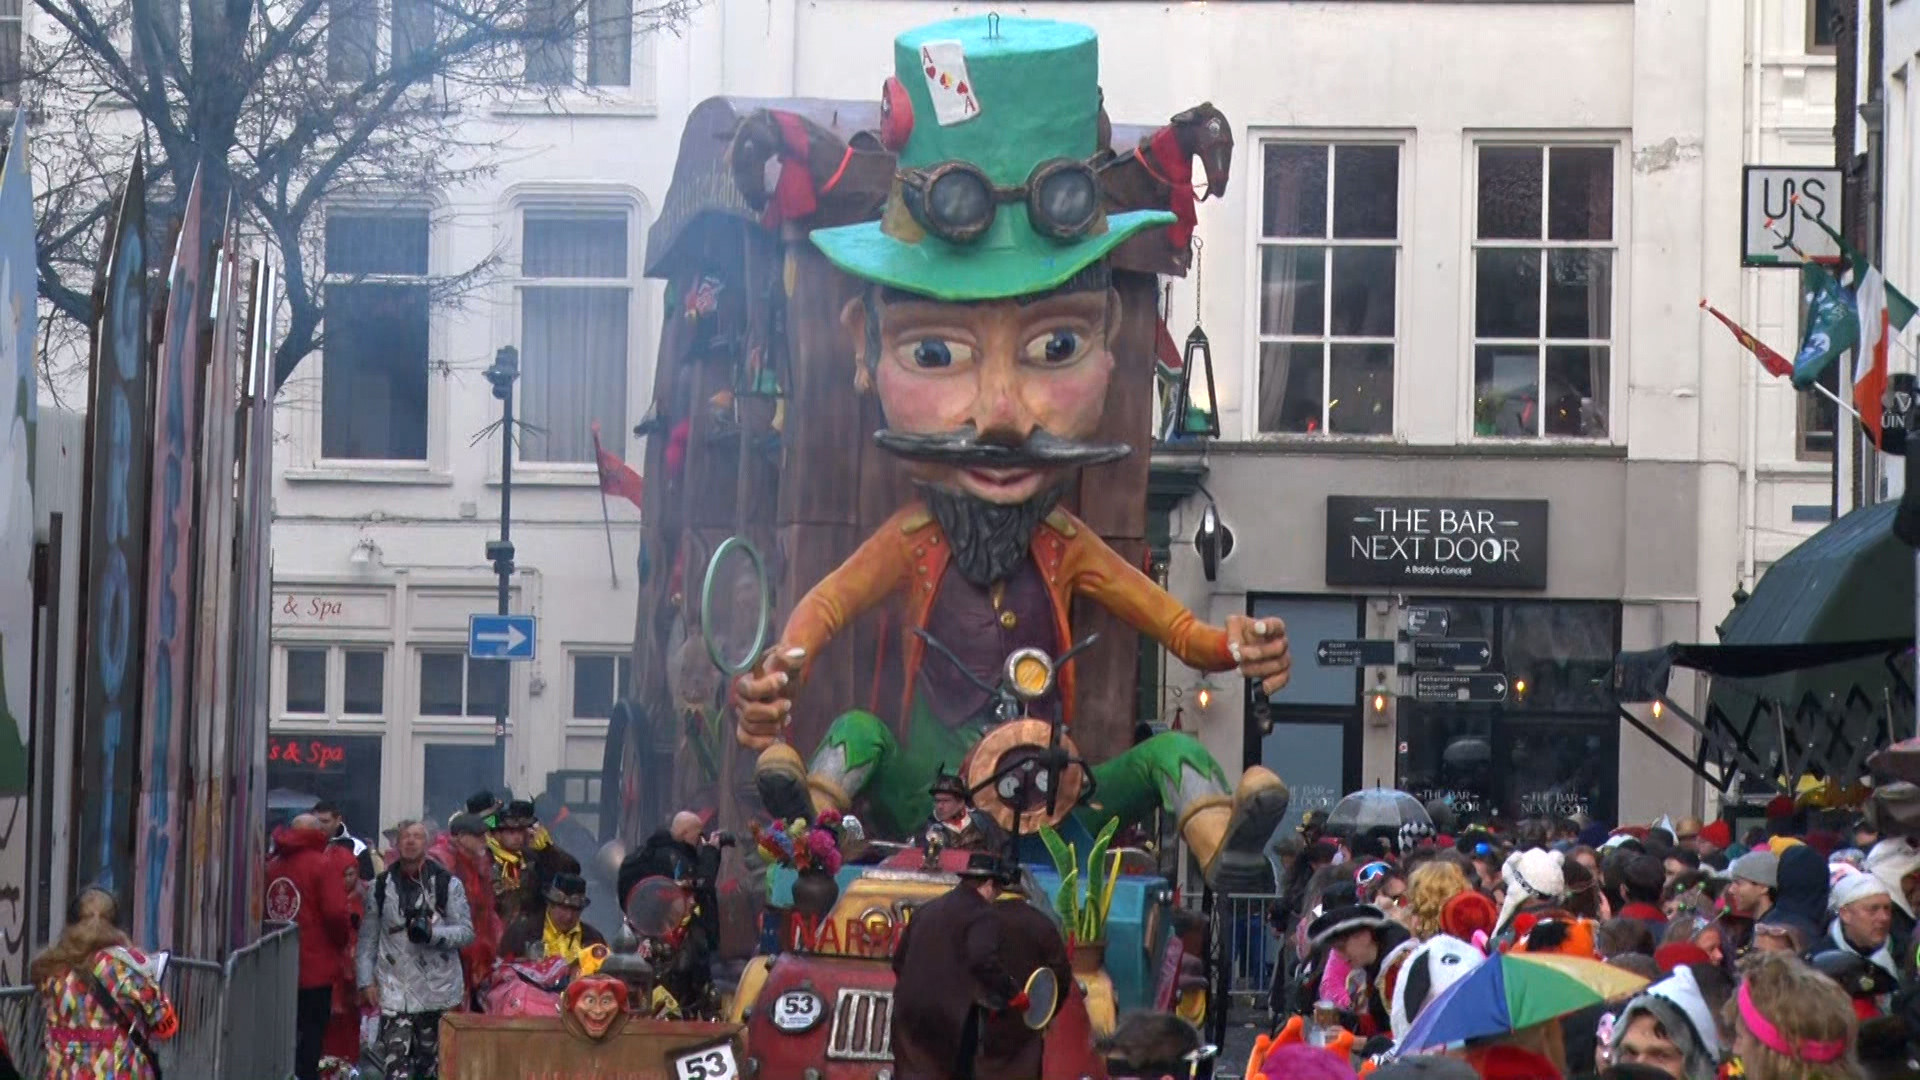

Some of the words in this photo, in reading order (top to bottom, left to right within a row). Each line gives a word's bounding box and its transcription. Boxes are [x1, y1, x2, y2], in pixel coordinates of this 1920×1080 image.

[1374, 507, 1431, 534] THE
[1439, 508, 1496, 534] BAR
[1351, 535, 1426, 560] NEXT
[1434, 536, 1520, 563] DOOR
[1405, 565, 1411, 574] A
[1412, 565, 1440, 576] Bobby's
[1441, 566, 1473, 577] Concept
[283, 595, 299, 618] &
[307, 596, 342, 621] Spa
[282, 741, 302, 763] &
[306, 741, 344, 769] Spa
[784, 995, 813, 1014] 53
[685, 1051, 728, 1080] 53
